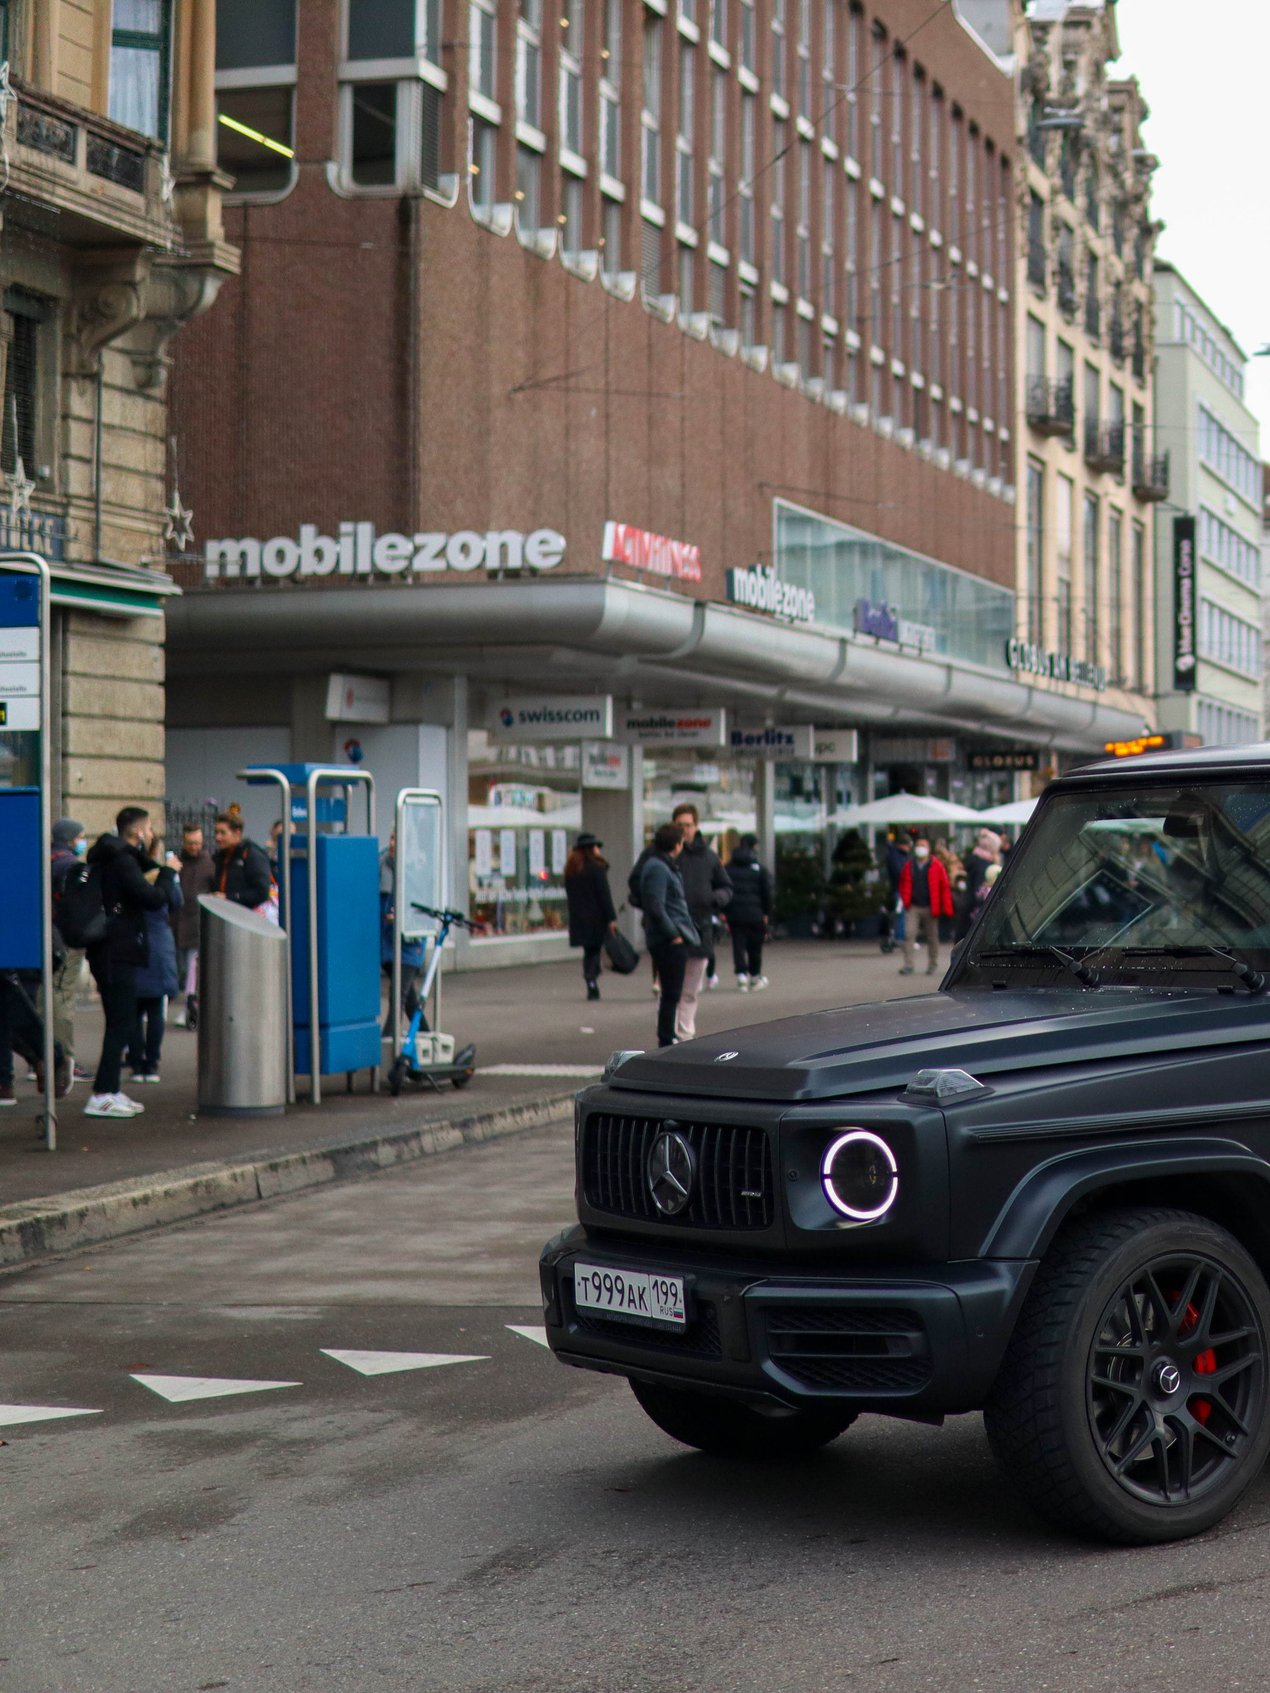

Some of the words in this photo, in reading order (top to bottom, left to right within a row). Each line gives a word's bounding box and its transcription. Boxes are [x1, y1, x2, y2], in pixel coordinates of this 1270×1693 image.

[205, 521, 566, 578] mobilezone
[1178, 539, 1192, 576] Corso
[733, 563, 815, 622] mobilezone
[519, 706, 600, 723] swisscom
[626, 715, 711, 730] mobilezone
[731, 729, 794, 746] Berlitz
[972, 755, 1034, 767] GLOBUS
[581, 1271, 648, 1312] T999AK
[652, 1279, 678, 1307] 199
[660, 1305, 674, 1317] RUS
